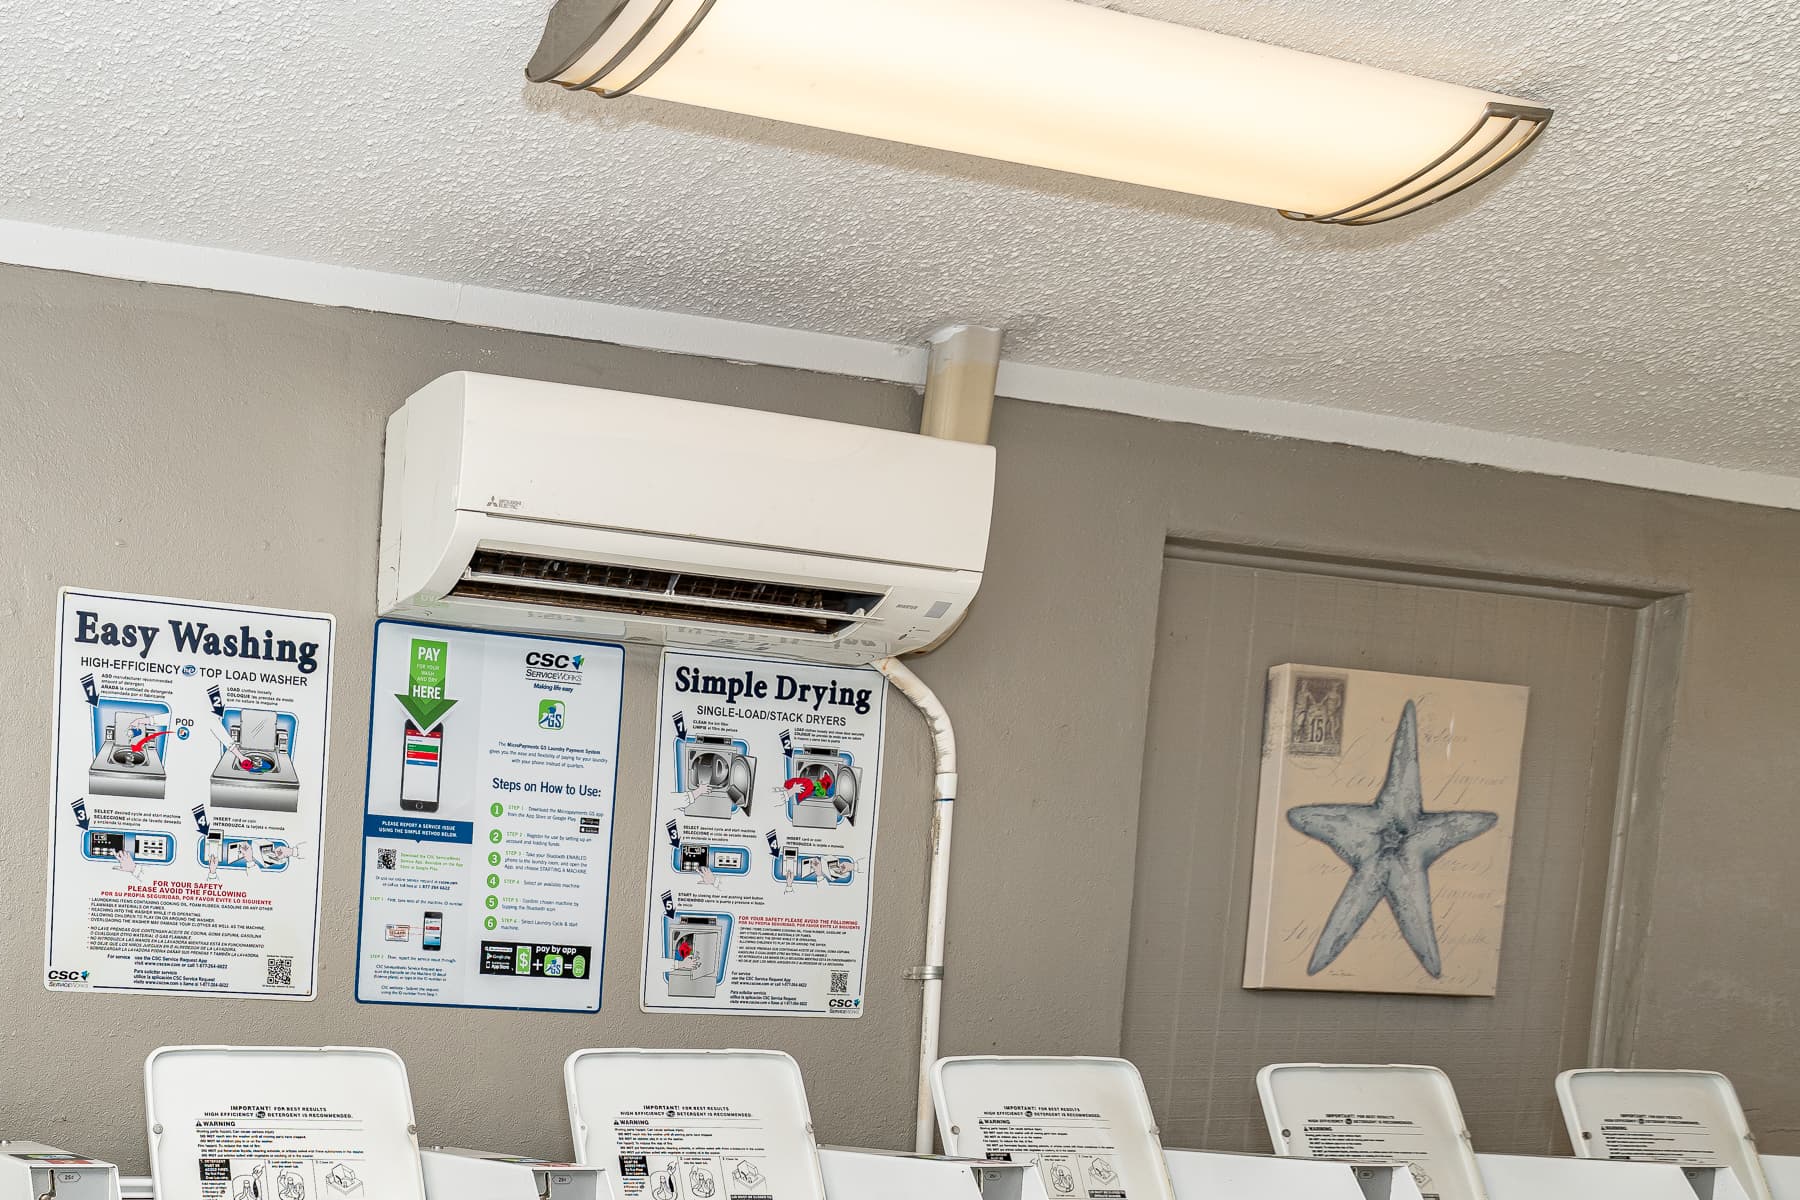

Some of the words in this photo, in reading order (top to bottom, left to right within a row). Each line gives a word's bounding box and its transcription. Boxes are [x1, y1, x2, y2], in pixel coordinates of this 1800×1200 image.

[74, 610, 160, 659] Easy
[168, 619, 319, 674] Washing
[418, 646, 441, 662] PAY
[526, 651, 570, 669] CSC
[80, 656, 181, 676] HIGH-EFFICIENCY
[200, 667, 222, 679] TOP
[225, 669, 257, 682] LOAD
[260, 673, 308, 687] WASHER
[412, 685, 442, 700] HERE
[533, 683, 552, 692] Making
[562, 686, 574, 694] easy
[675, 665, 768, 705] Simple
[774, 674, 873, 715] Drying
[212, 696, 222, 708] 2
[696, 705, 804, 723] SINGLE-LOAD/STACK
[806, 714, 847, 727] DRYERS
[175, 718, 195, 727] POD
[784, 739, 792, 750] 2
[492, 777, 521, 793] Steps
[524, 782, 537, 792] on
[540, 781, 562, 794] How
[566, 784, 576, 795] to
[579, 784, 602, 798] Use:
[77, 809, 86, 821] 3
[494, 805, 500, 815] 1
[197, 815, 207, 826] 4
[493, 832, 500, 841] 2
[670, 830, 678, 840] 3
[492, 854, 498, 864] 3
[489, 876, 496, 886] 4
[127, 886, 158, 894] PLEASE
[202, 890, 247, 898] FOLLOWING
[194, 883, 223, 891] SAFETY
[489, 897, 495, 907] 5
[665, 901, 673, 911] 5
[488, 918, 494, 928] 6
[535, 945, 550, 954] pay
[551, 945, 561, 954] by
[561, 947, 577, 955] app
[48, 970, 80, 981] CSC
[828, 999, 853, 1008] CSC
